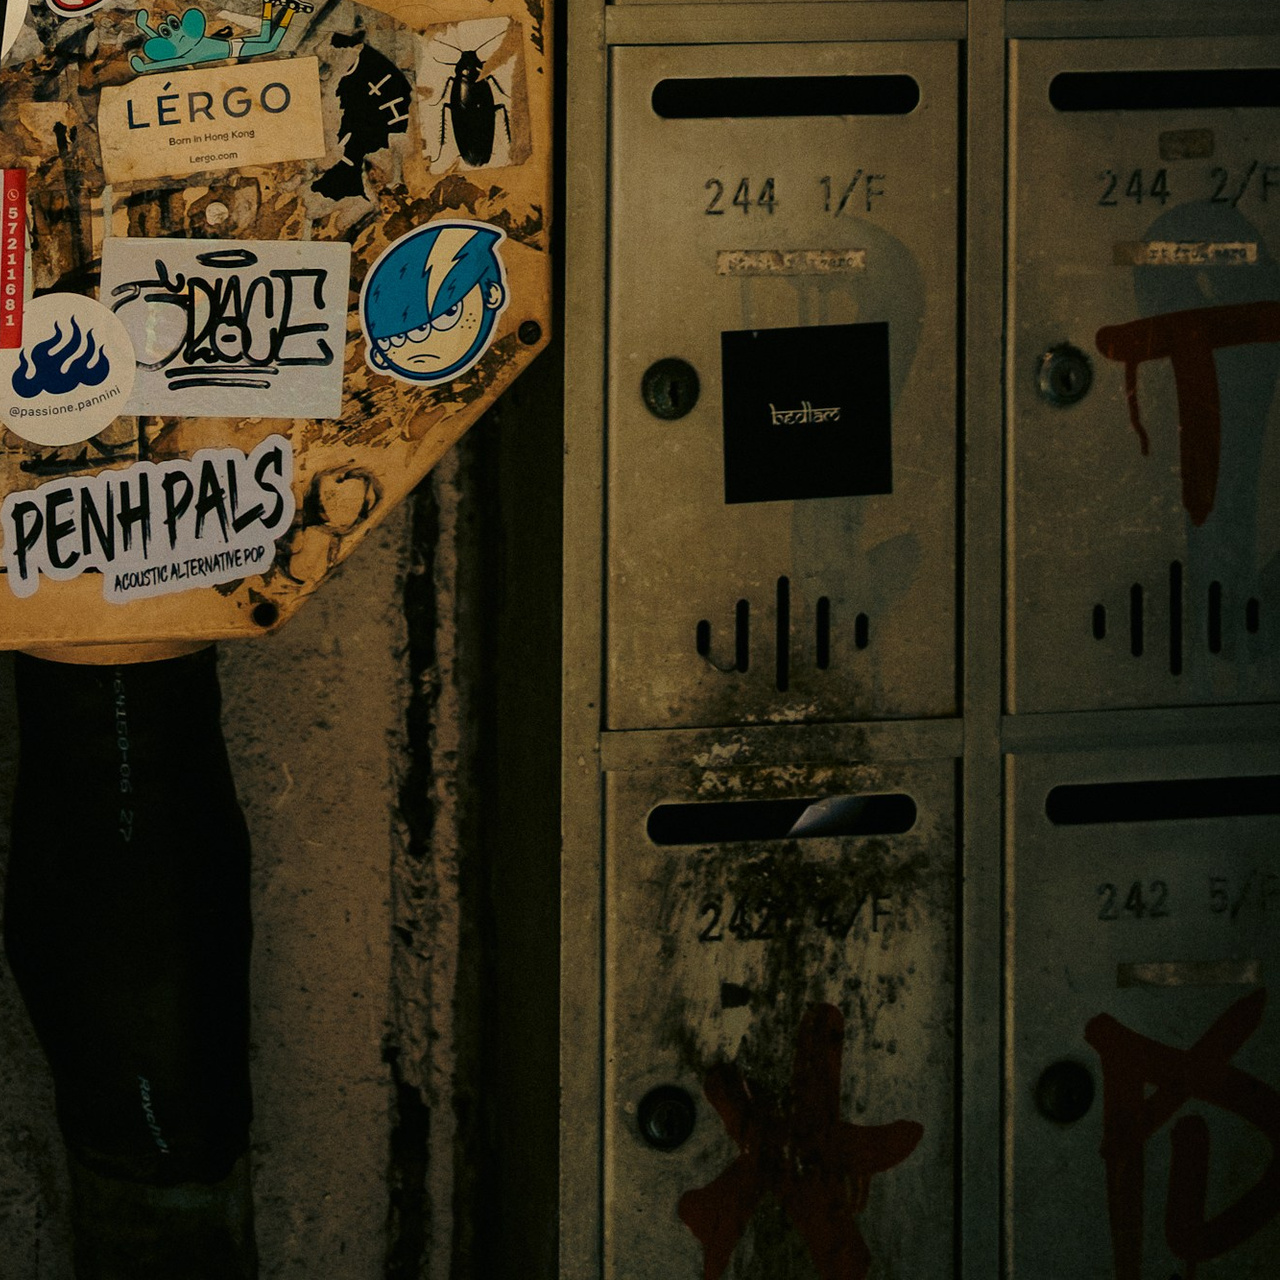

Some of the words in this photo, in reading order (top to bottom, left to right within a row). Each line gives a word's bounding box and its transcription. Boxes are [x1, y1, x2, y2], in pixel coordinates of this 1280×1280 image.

[127, 82, 290, 129] LÉRGO
[169, 137, 191, 145] Born
[205, 133, 228, 142] Hong
[232, 130, 255, 139] Kong
[189, 152, 238, 163] Lergo.com
[704, 178, 779, 216] 244
[820, 169, 886, 218] 1/F
[1098, 169, 1170, 207] 244
[5, 207, 18, 326] 57211681
[9, 386, 120, 417] @passione.pannini
[770, 401, 841, 426] bedlam
[12, 473, 152, 580] PENH
[162, 447, 284, 550] PALS
[114, 565, 169, 591] ACOUSTIC
[171, 549, 243, 579] ALTERNATIVE
[244, 546, 265, 567] POP
[698, 895, 772, 942] 242
[1098, 880, 1169, 922] 242
